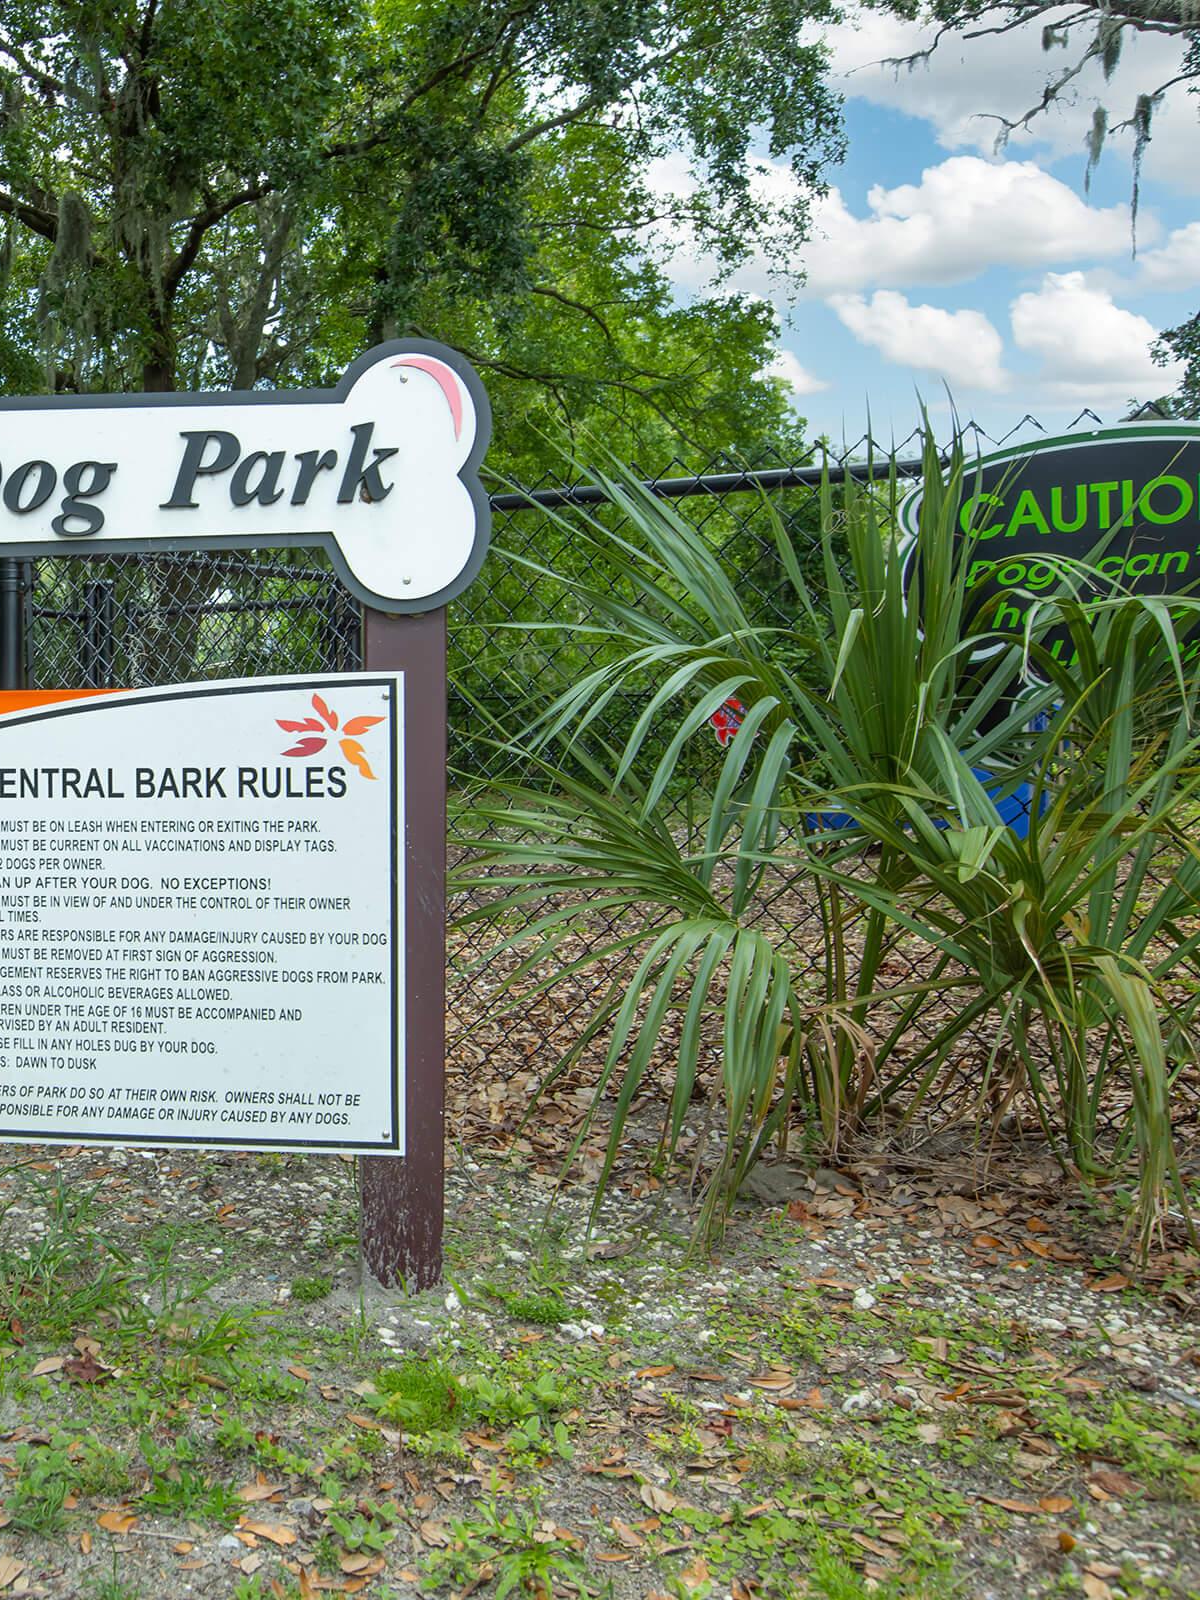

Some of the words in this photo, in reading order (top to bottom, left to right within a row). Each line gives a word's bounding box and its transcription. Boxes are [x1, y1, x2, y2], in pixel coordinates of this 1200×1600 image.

[159, 421, 400, 508] Park
[959, 474, 1200, 540] CAUTIO
[135, 767, 227, 798] BARK
[238, 766, 347, 798] RULES
[0, 820, 29, 832] MUST
[32, 820, 46, 832] BE
[49, 820, 64, 832] ON
[67, 820, 102, 832] LEASH
[105, 820, 137, 832] WHEN
[140, 820, 195, 833] ENTERING
[198, 820, 214, 833] OR
[216, 820, 260, 832] EXITING
[262, 820, 284, 833] THE
[287, 820, 321, 832] PARK.
[0, 839, 29, 851] MUST
[32, 839, 47, 851] BE
[49, 839, 100, 851] CURRENT
[102, 839, 118, 851] ON
[121, 839, 142, 852] ALL
[144, 839, 225, 852] VACCINATIONS
[227, 839, 252, 852] AND
[254, 839, 301, 852] DISPLAY
[304, 839, 337, 852] TAGS.
[5, 857, 36, 870] DOGS
[38, 857, 60, 870] PER
[62, 858, 105, 870] OWNER.
[14, 876, 31, 889] UP
[34, 876, 77, 889] AFTER
[80, 876, 117, 889] YOUR
[121, 877, 153, 890] DOG.
[160, 877, 180, 890] NO
[183, 877, 271, 890] EXCEPTIONS!
[1, 895, 29, 907] MUST
[32, 895, 47, 907] BE
[50, 895, 60, 907] IN
[63, 895, 90, 908] VIEW
[92, 895, 106, 908] OF
[109, 896, 132, 908] AND
[135, 896, 173, 909] UNDER
[175, 896, 197, 909] THE
[199, 896, 252, 909] CONTROL
[255, 896, 270, 909] OF
[273, 897, 306, 910] THEIR
[308, 897, 351, 910] OWNER
[7, 910, 41, 923] TIMES.
[16, 929, 39, 941] ARE
[41, 929, 116, 942] RESPONSIBLE
[118, 930, 141, 942] FOR
[143, 930, 166, 943] ANY
[168, 931, 258, 944] DAMAGE/INJURY
[260, 931, 306, 944] CAUSED
[309, 932, 325, 945] BY
[327, 932, 359, 945] YOUR
[362, 932, 387, 945] DOG
[1, 947, 31, 960] MUST
[33, 947, 48, 960] BE
[50, 948, 103, 961] REMOVED
[105, 948, 120, 960] AT
[122, 949, 153, 961] FIRST
[155, 949, 181, 962] SIGN
[184, 950, 199, 962] OF
[201, 950, 277, 963] AGGRESSION.
[46, 966, 102, 979] RESERVES
[104, 967, 126, 980] THE
[129, 968, 162, 980] RIGHT
[164, 968, 179, 981] TO
[182, 969, 205, 981] BAN
[207, 969, 279, 982] AGGRESSIVE
[281, 970, 314, 983] DOGS
[316, 970, 348, 983] FROM
[351, 971, 386, 984] PARK.
[24, 985, 41, 997] OR
[43, 985, 105, 998] ALCOHOLIC
[107, 986, 174, 1000] BEVERAGES
[176, 988, 233, 1001] ALLOWED.
[24, 1004, 61, 1016] UNDER
[63, 1004, 85, 1017] THE
[87, 1005, 110, 1017] AGE
[112, 1005, 127, 1018] OF
[131, 1006, 142, 1018] 16
[144, 1006, 175, 1018] MUST
[177, 1006, 192, 1019] BE
[195, 1007, 276, 1020] ACCOMPANIED
[278, 1008, 302, 1021] AND
[38, 1019, 52, 1031] BY
[54, 1020, 70, 1032] AN
[72, 1020, 108, 1033] ADULT
[111, 1020, 167, 1034] RESIDENT.
[13, 1037, 35, 1050] FILL
[37, 1038, 48, 1050] IN
[50, 1038, 72, 1050] ANY
[75, 1039, 111, 1052] HOLES
[113, 1039, 137, 1052] DUG
[139, 1040, 154, 1052] BY
[157, 1040, 188, 1053] YOUR
[190, 1041, 218, 1054] DOG.
[15, 1056, 47, 1068] DAWN
[50, 1056, 65, 1069] TO
[67, 1057, 96, 1070] DUSK
[19, 1085, 35, 1097] OF
[36, 1085, 68, 1098] PARK
[69, 1086, 86, 1099] DO
[88, 1087, 105, 1100] SO
[107, 1087, 123, 1100] AT
[125, 1088, 157, 1101] THEIR
[159, 1089, 187, 1102] OWN
[189, 1090, 218, 1103] RISK.
[224, 1091, 275, 1104] OWNERS
[277, 1092, 314, 1105] SHALL
[317, 1093, 343, 1106] NOT
[344, 1093, 361, 1106] BE
[55, 1104, 79, 1117] FOR
[80, 1106, 105, 1118] ANY
[106, 1106, 155, 1120] DAMAGE
[157, 1107, 175, 1120] OR
[176, 1108, 218, 1121] INJURY
[220, 1109, 267, 1123] CAUSED
[270, 1110, 287, 1123] BY
[287, 1111, 313, 1124] ANY
[314, 1112, 351, 1125] DOGS.
